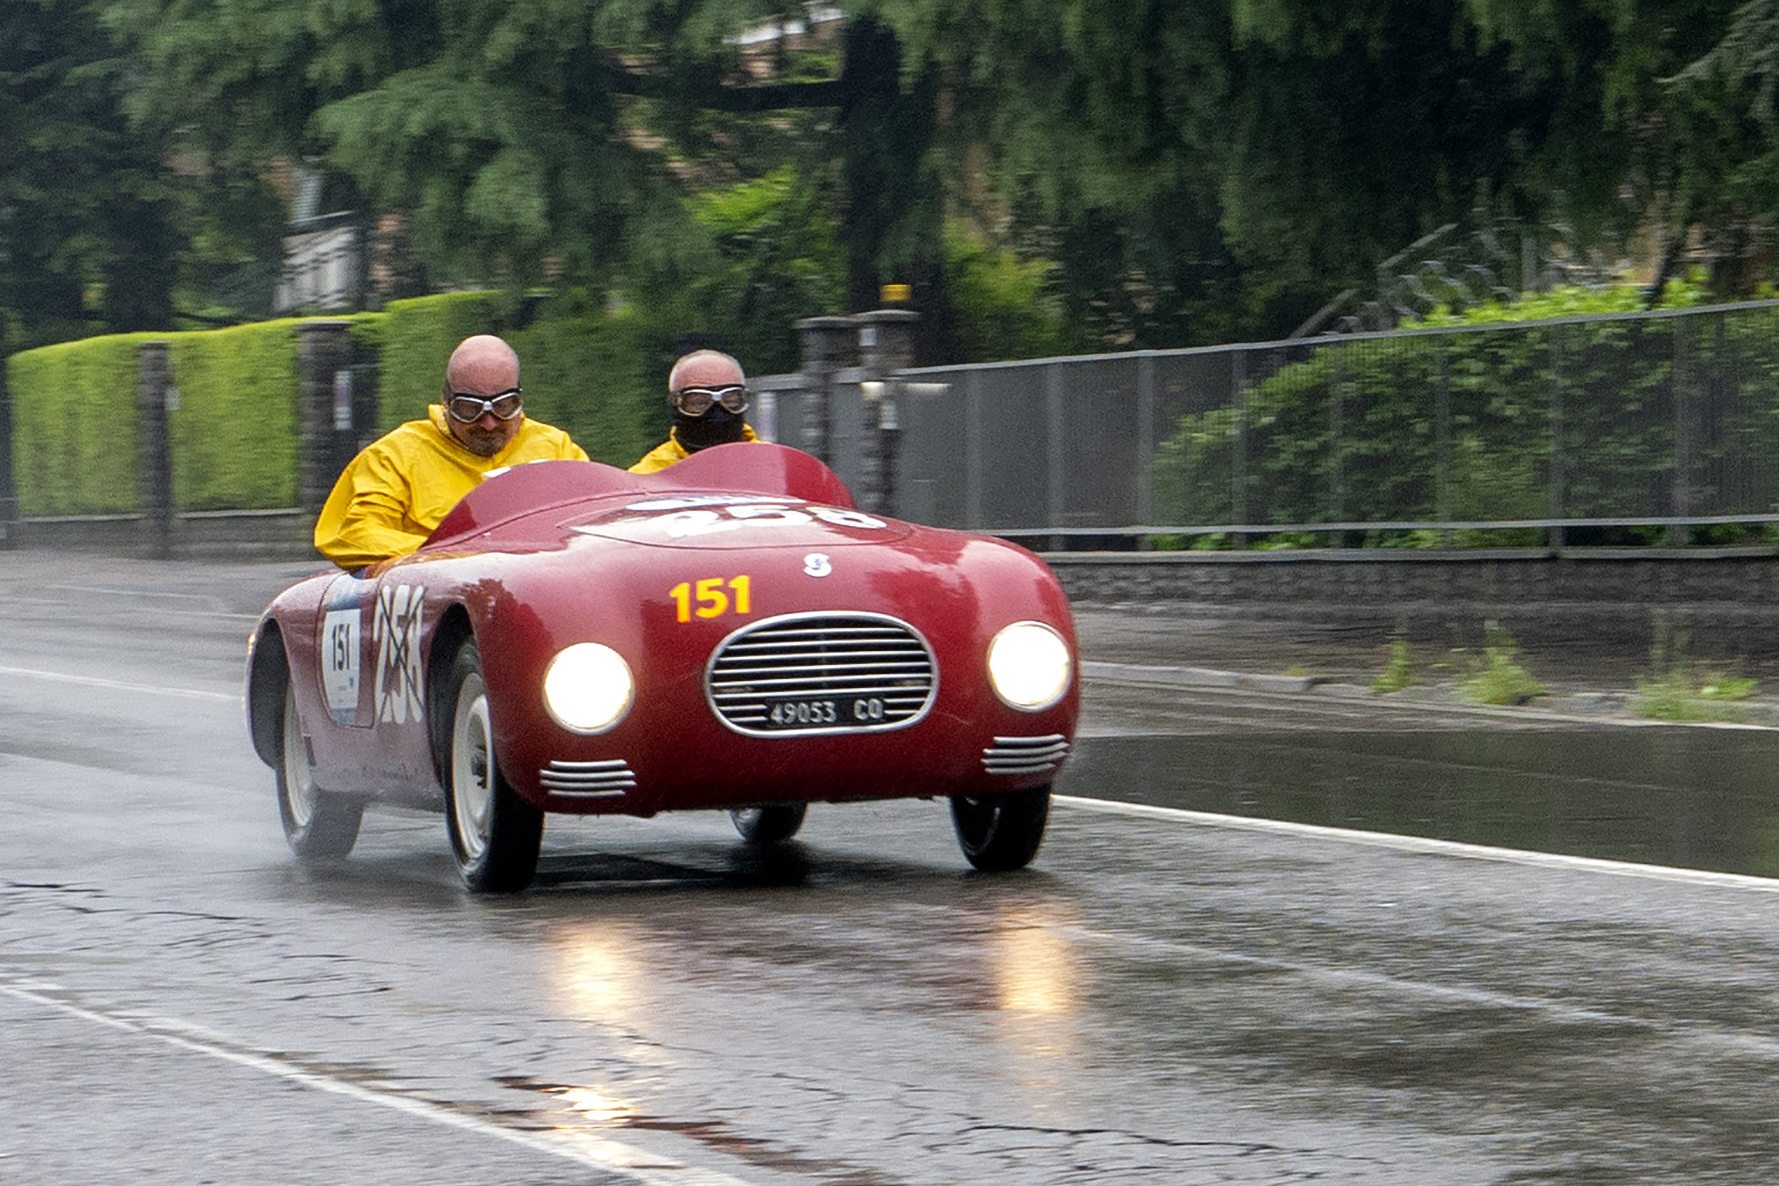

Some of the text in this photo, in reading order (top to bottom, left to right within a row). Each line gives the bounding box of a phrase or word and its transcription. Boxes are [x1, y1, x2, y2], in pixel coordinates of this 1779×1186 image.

[669, 575, 750, 623] 151
[332, 623, 351, 671] 151
[770, 698, 884, 724] 49053 CO
